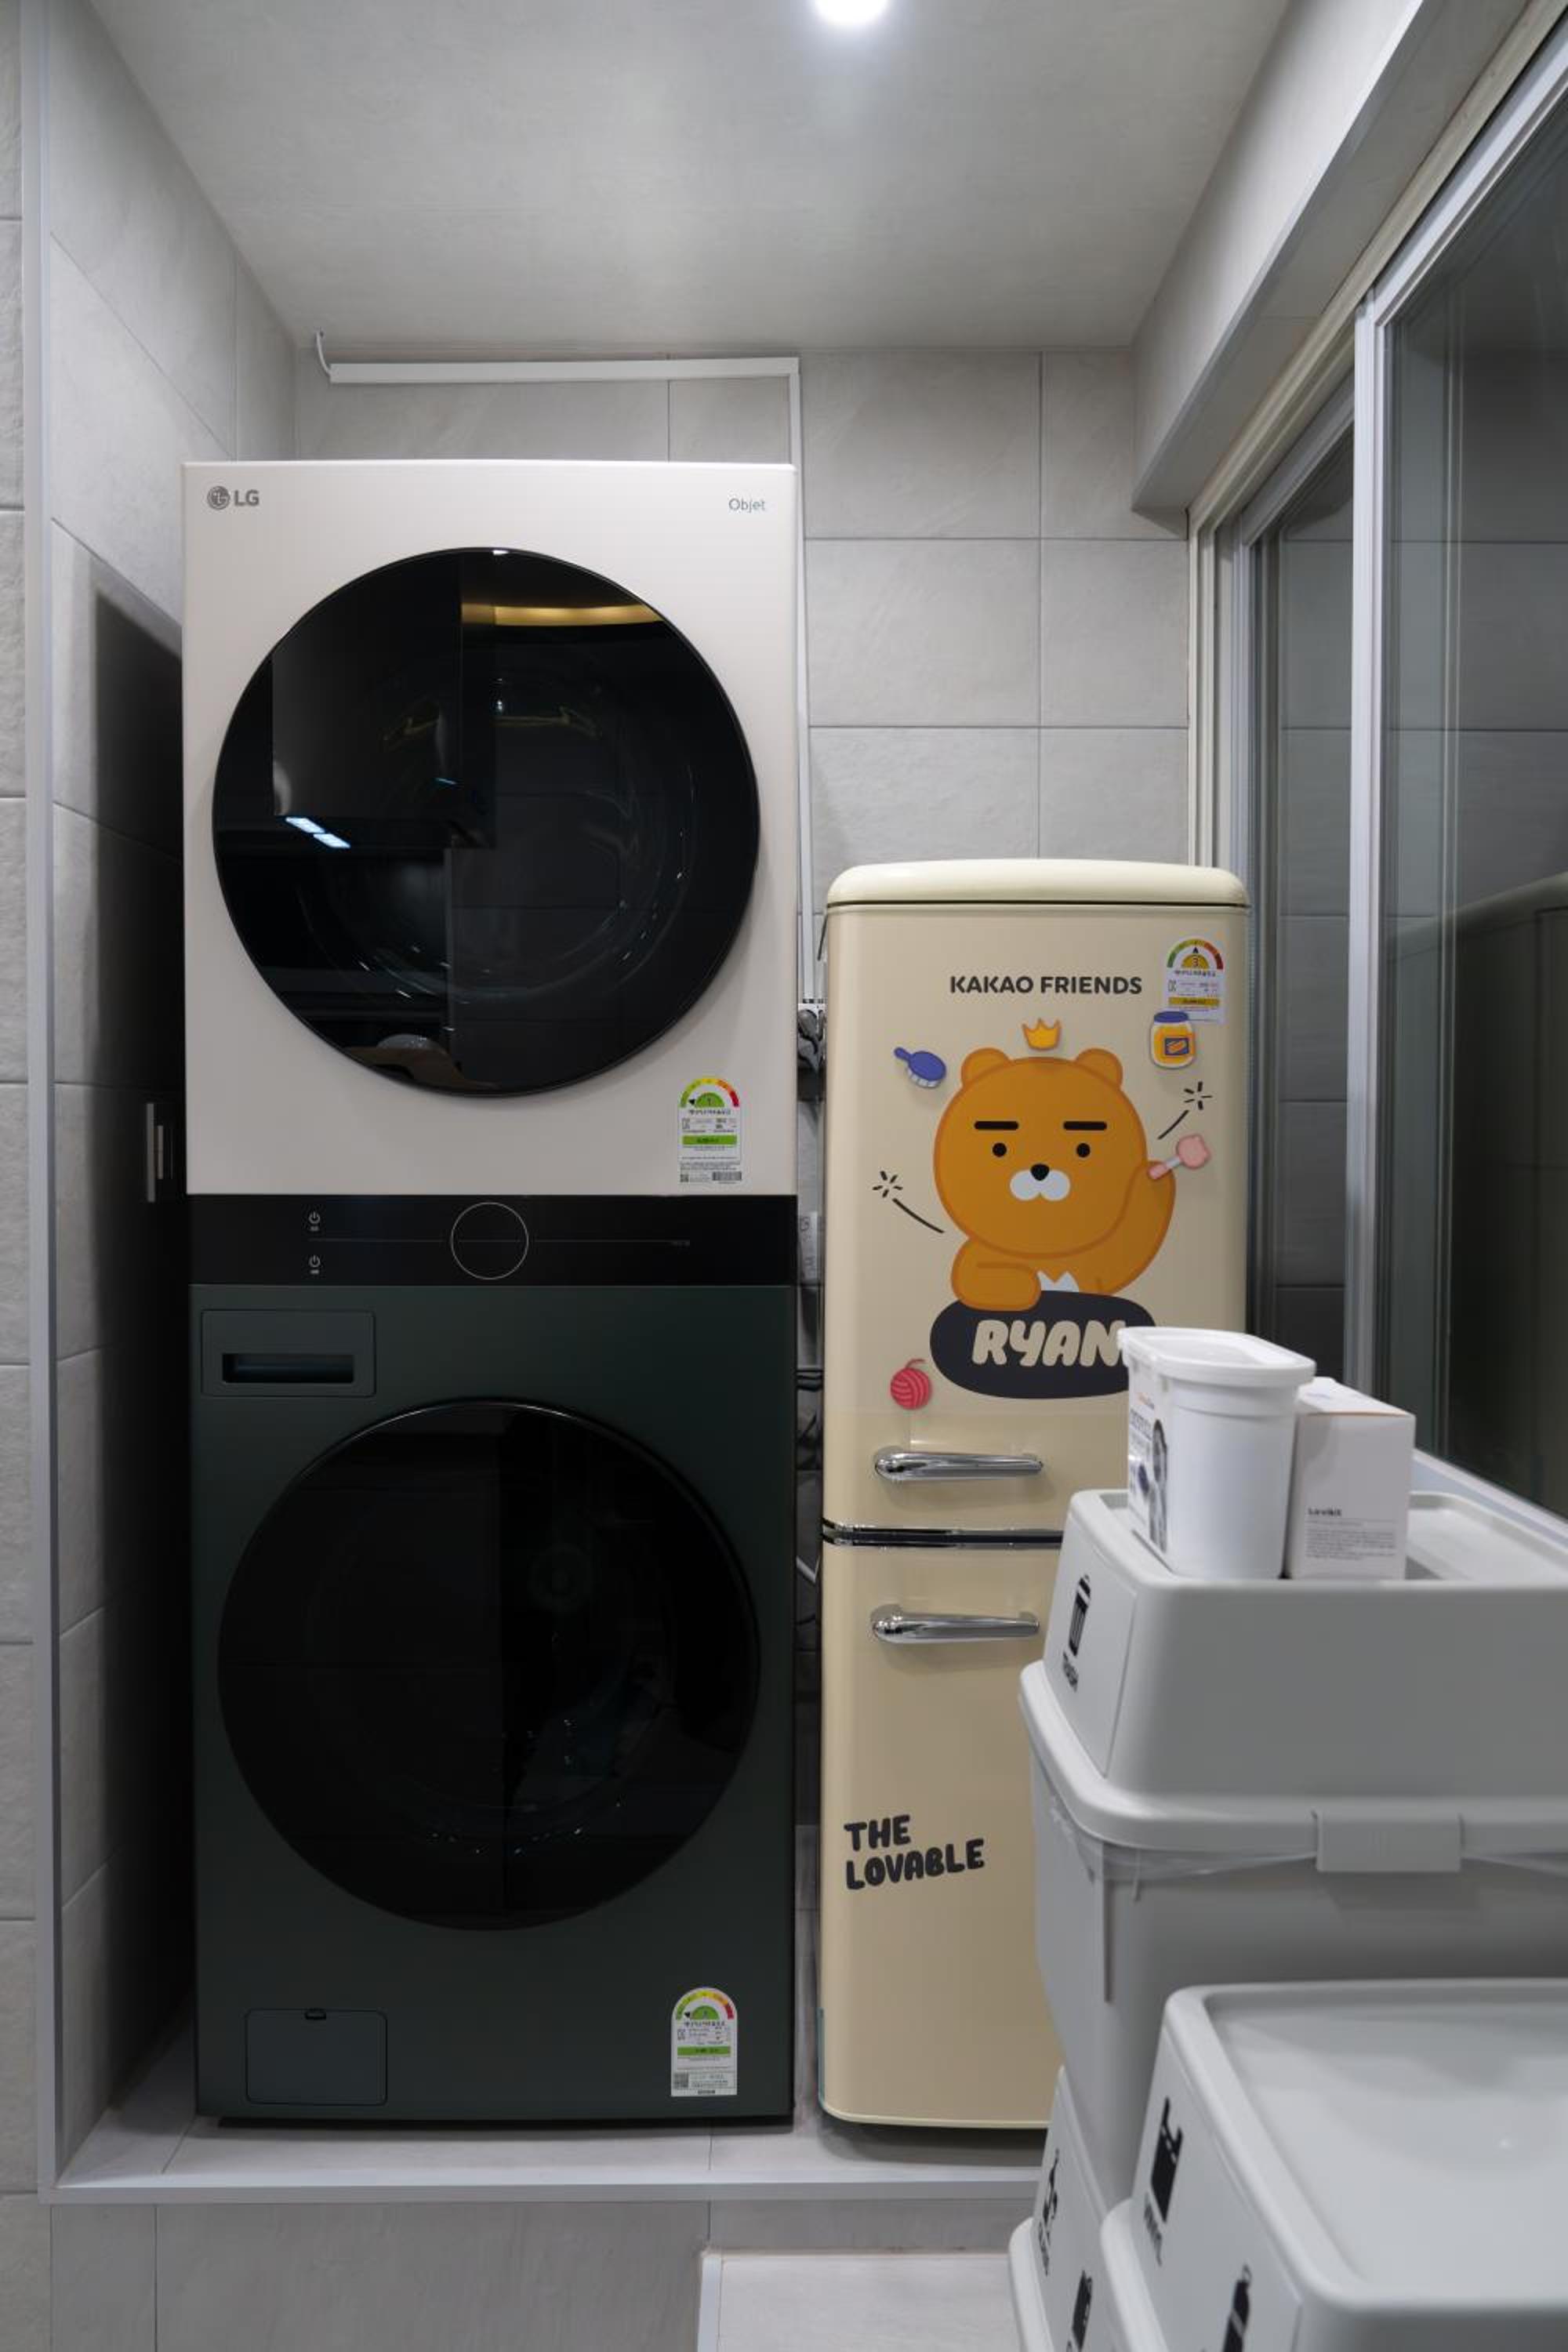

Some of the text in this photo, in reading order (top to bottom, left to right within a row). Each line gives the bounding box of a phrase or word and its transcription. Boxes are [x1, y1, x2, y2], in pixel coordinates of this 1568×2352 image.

[234, 489, 260, 506] LG
[728, 497, 766, 514] Objet
[950, 975, 1143, 994] KAKAO FRIENDS
[971, 1319, 1127, 1367] RYAN
[844, 1814, 911, 1852] THE
[846, 1838, 985, 1890] LOVABLE
